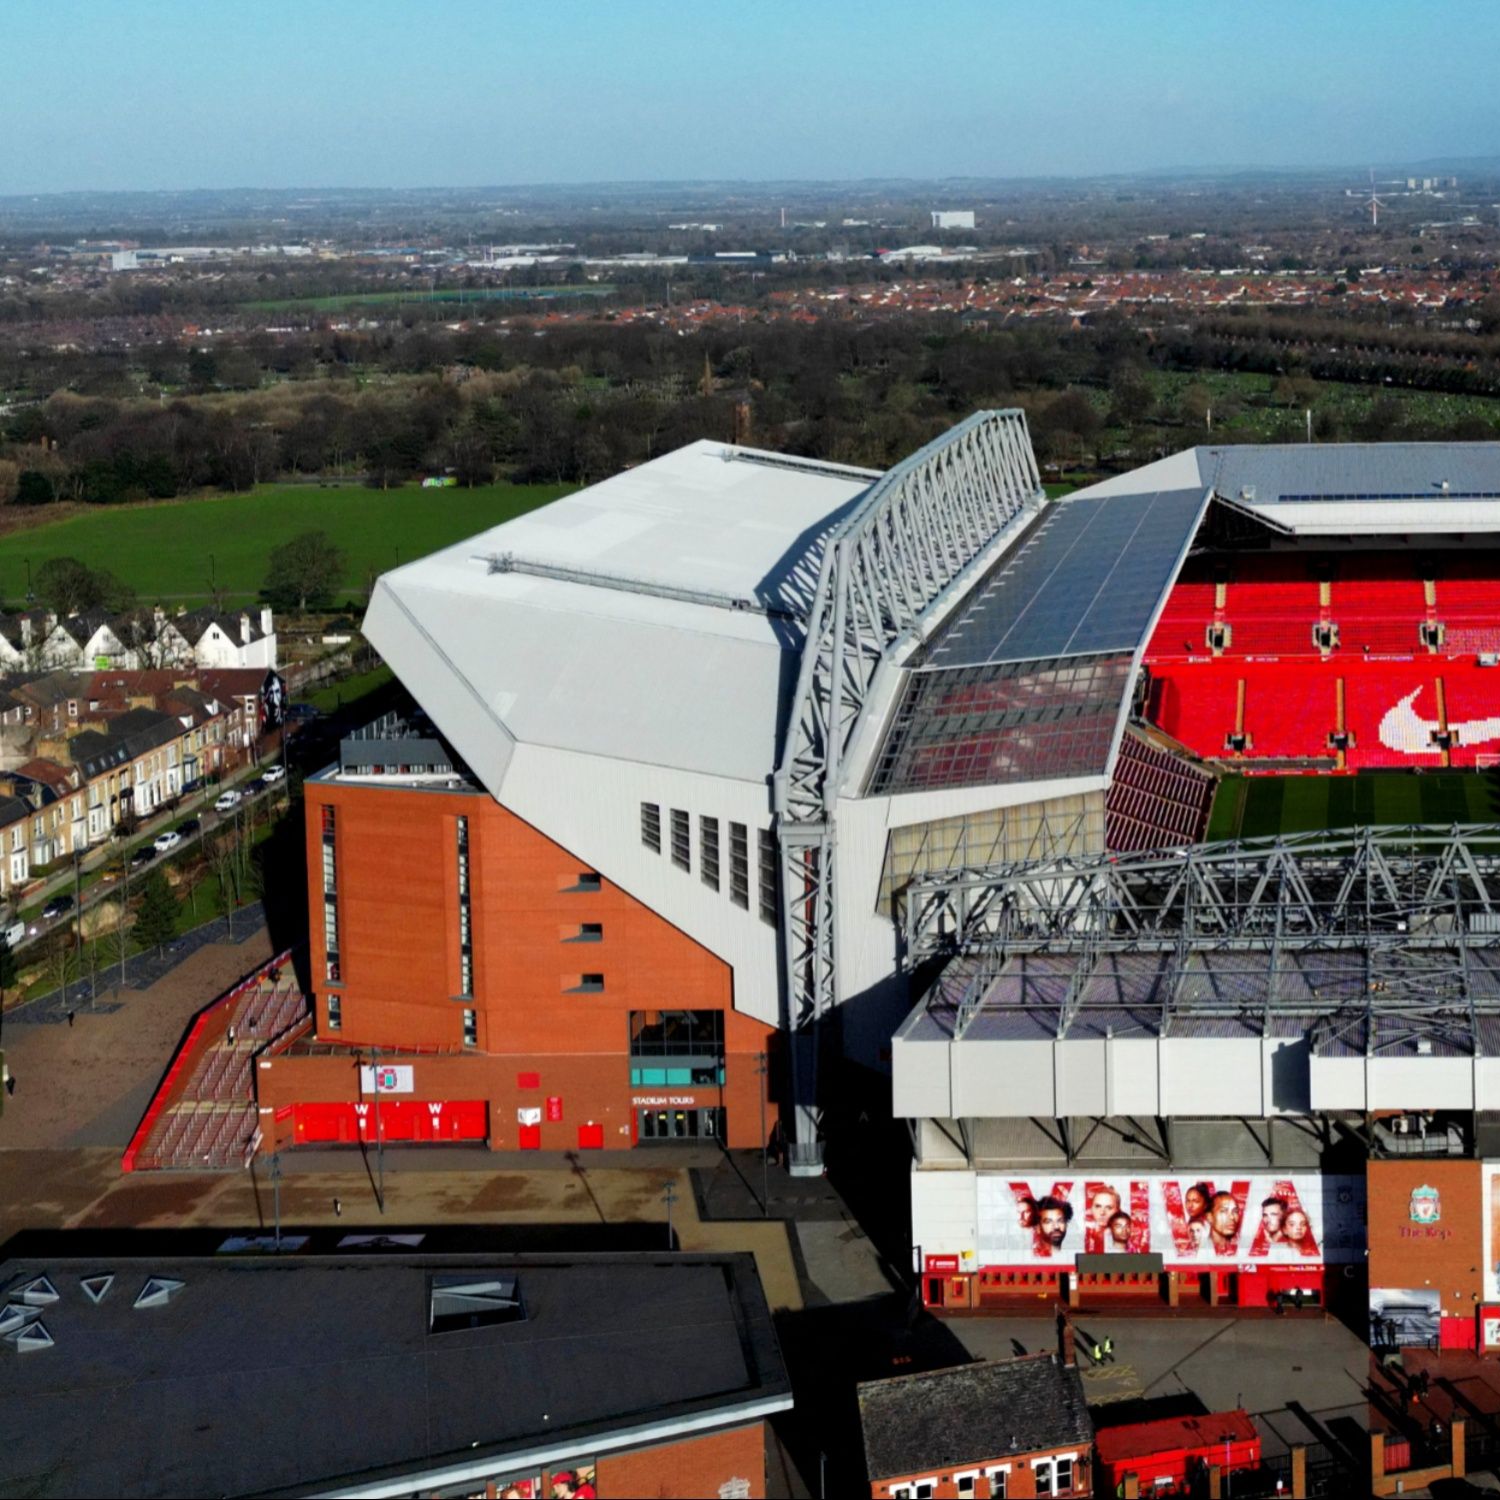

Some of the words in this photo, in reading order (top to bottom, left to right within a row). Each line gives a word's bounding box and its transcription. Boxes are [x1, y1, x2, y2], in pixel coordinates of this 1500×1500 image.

[632, 1096, 667, 1105] STADIUM
[669, 1096, 695, 1105] TOURS
[355, 1104, 369, 1115] W
[428, 1103, 443, 1114] W
[1009, 1181, 1322, 1257] YNWA
[1399, 1224, 1423, 1238] The
[1425, 1226, 1453, 1241] Kop
